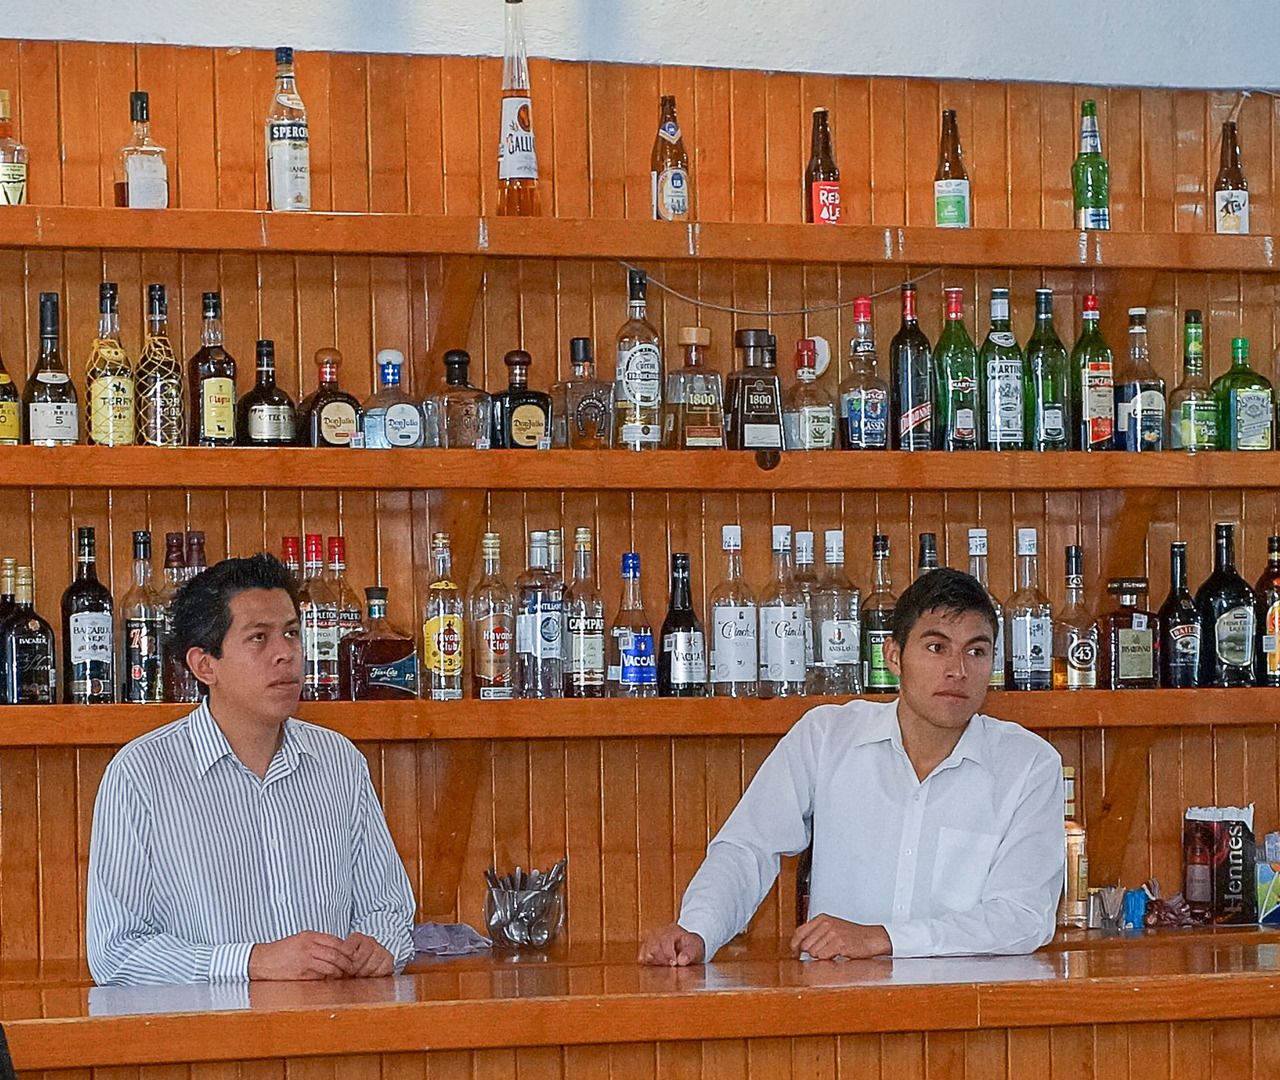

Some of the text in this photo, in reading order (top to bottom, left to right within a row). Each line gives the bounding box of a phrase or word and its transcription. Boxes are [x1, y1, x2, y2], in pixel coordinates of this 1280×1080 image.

[820, 190, 840, 205] RED
[820, 207, 841, 220] ALE
[689, 393, 716, 405] 1800
[749, 394, 772, 405] 1800
[55, 416, 64, 425] 5
[490, 641, 510, 650] Club
[1074, 646, 1091, 661] 43
[447, 658, 453, 666] 3
[1224, 822, 1243, 913] Hennes
